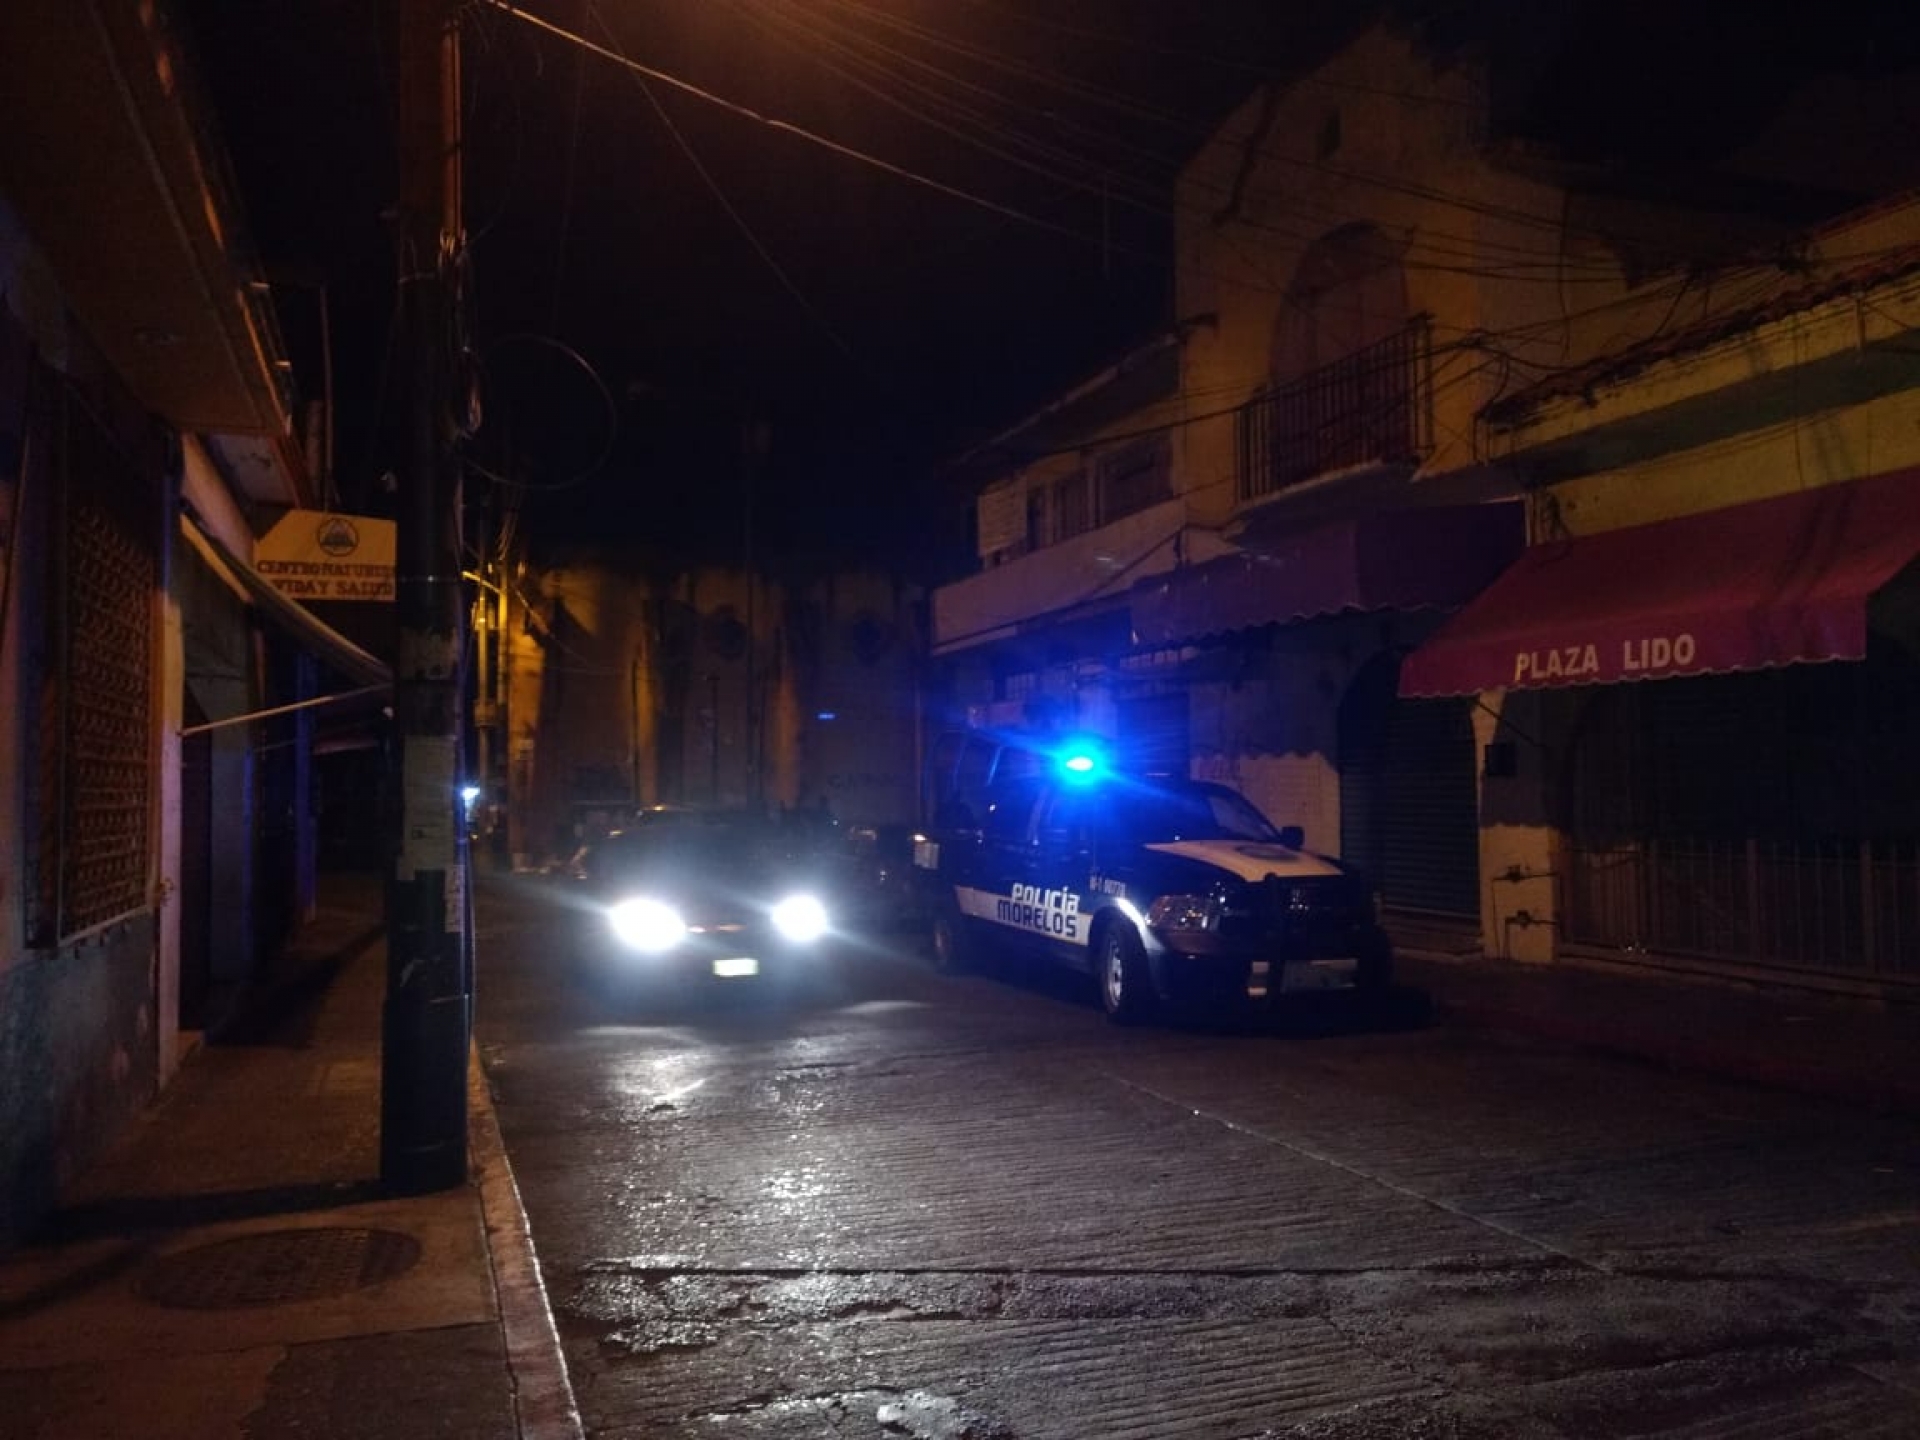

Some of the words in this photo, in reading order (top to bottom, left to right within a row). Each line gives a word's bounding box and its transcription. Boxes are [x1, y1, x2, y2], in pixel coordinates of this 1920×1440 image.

[1514, 643, 1600, 682] PLAZA
[1622, 632, 1696, 671] LIDO
[997, 899, 1077, 938] MORELOS
